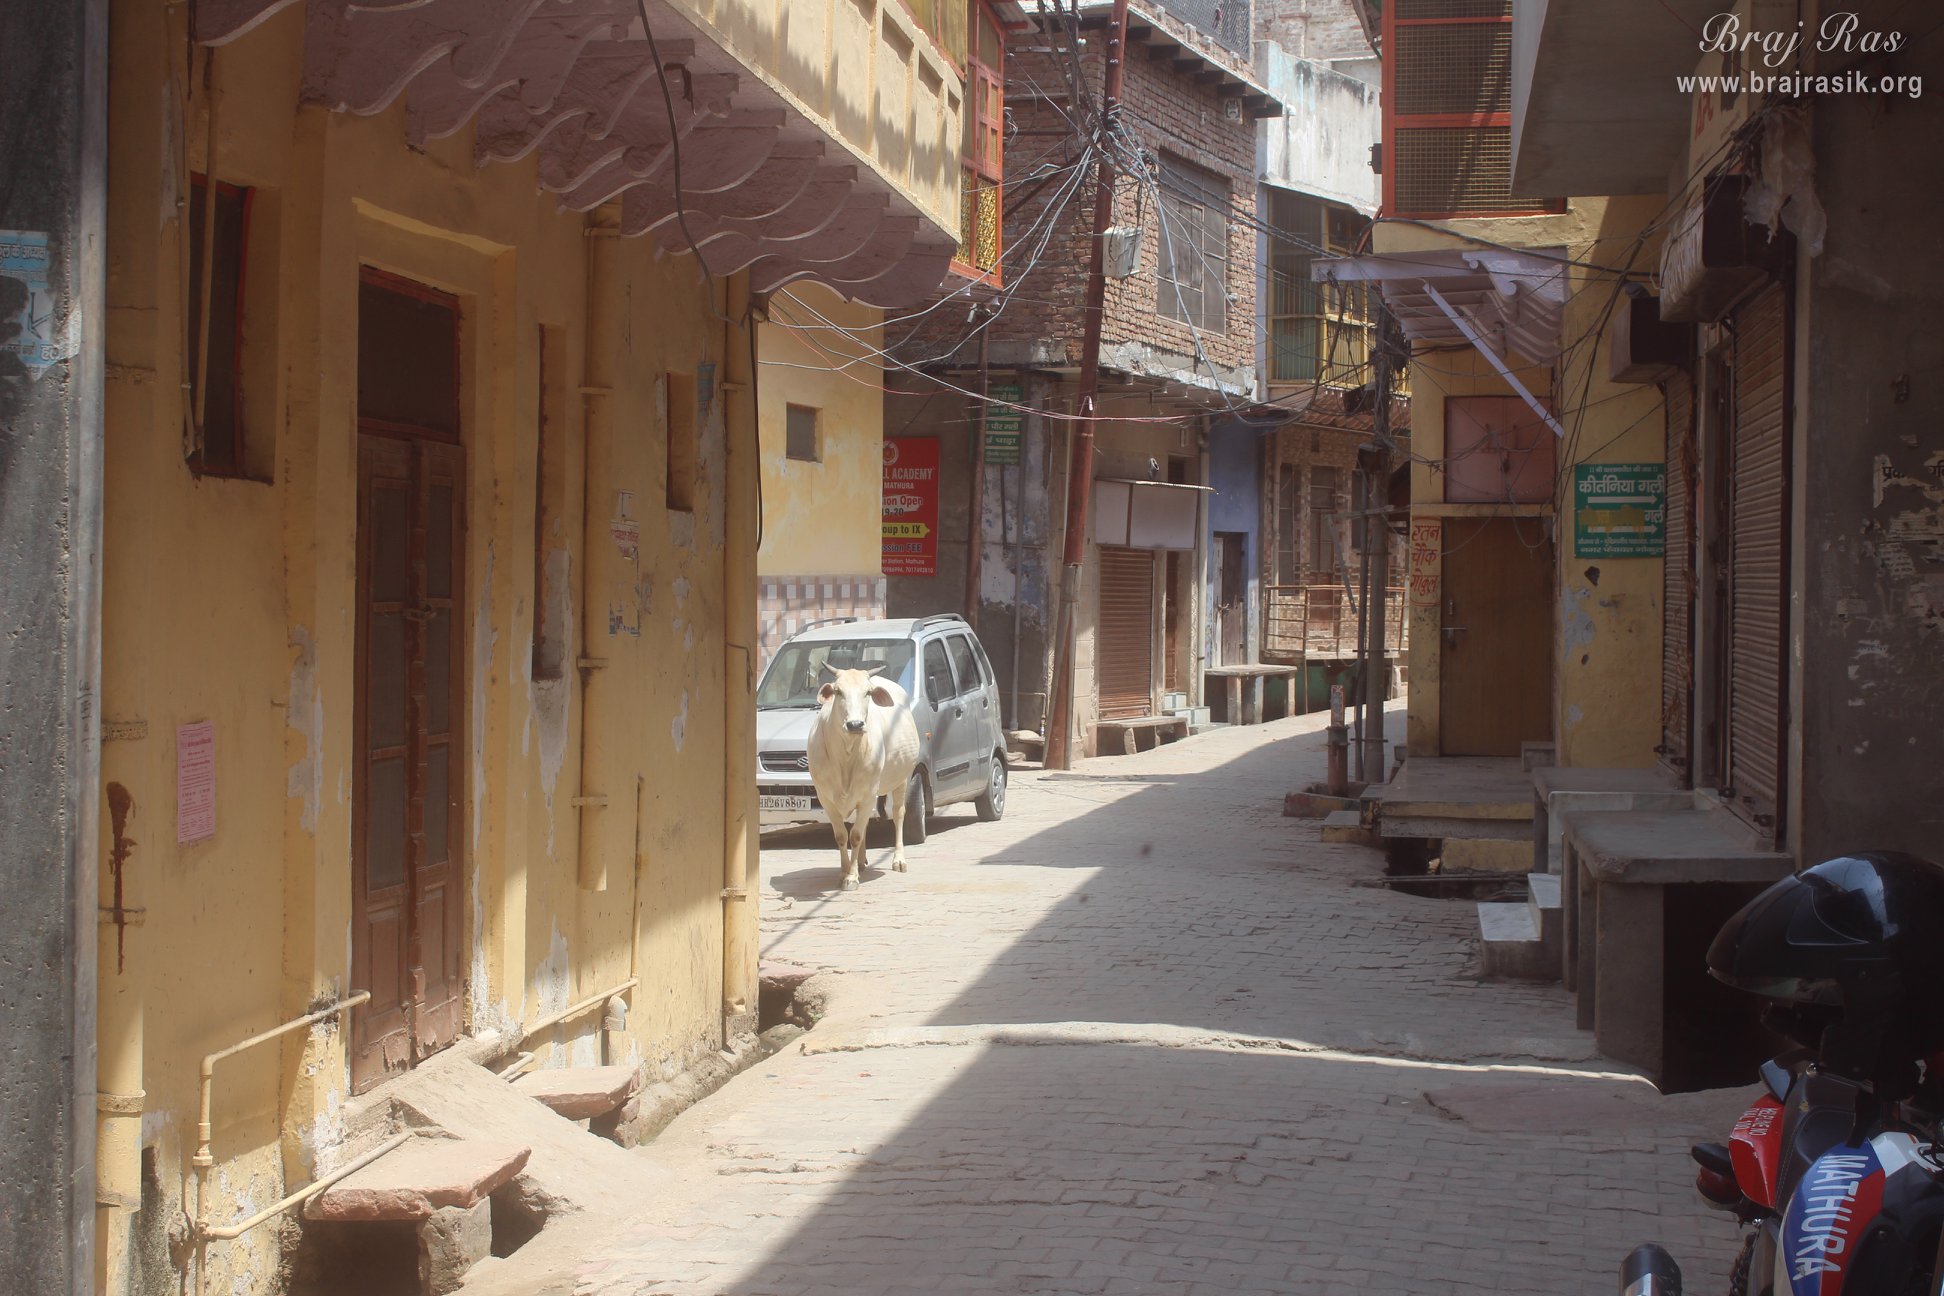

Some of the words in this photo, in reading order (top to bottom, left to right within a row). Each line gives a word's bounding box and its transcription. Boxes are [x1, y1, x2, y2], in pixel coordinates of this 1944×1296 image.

[892, 467, 932, 480] ACADEMY
[900, 496, 923, 507] Open
[901, 525, 909, 534] to
[912, 525, 920, 534] IX
[906, 543, 921, 552] FEE
[760, 798, 807, 808] HR26V8807
[1792, 1155, 1869, 1281] MATHURA
